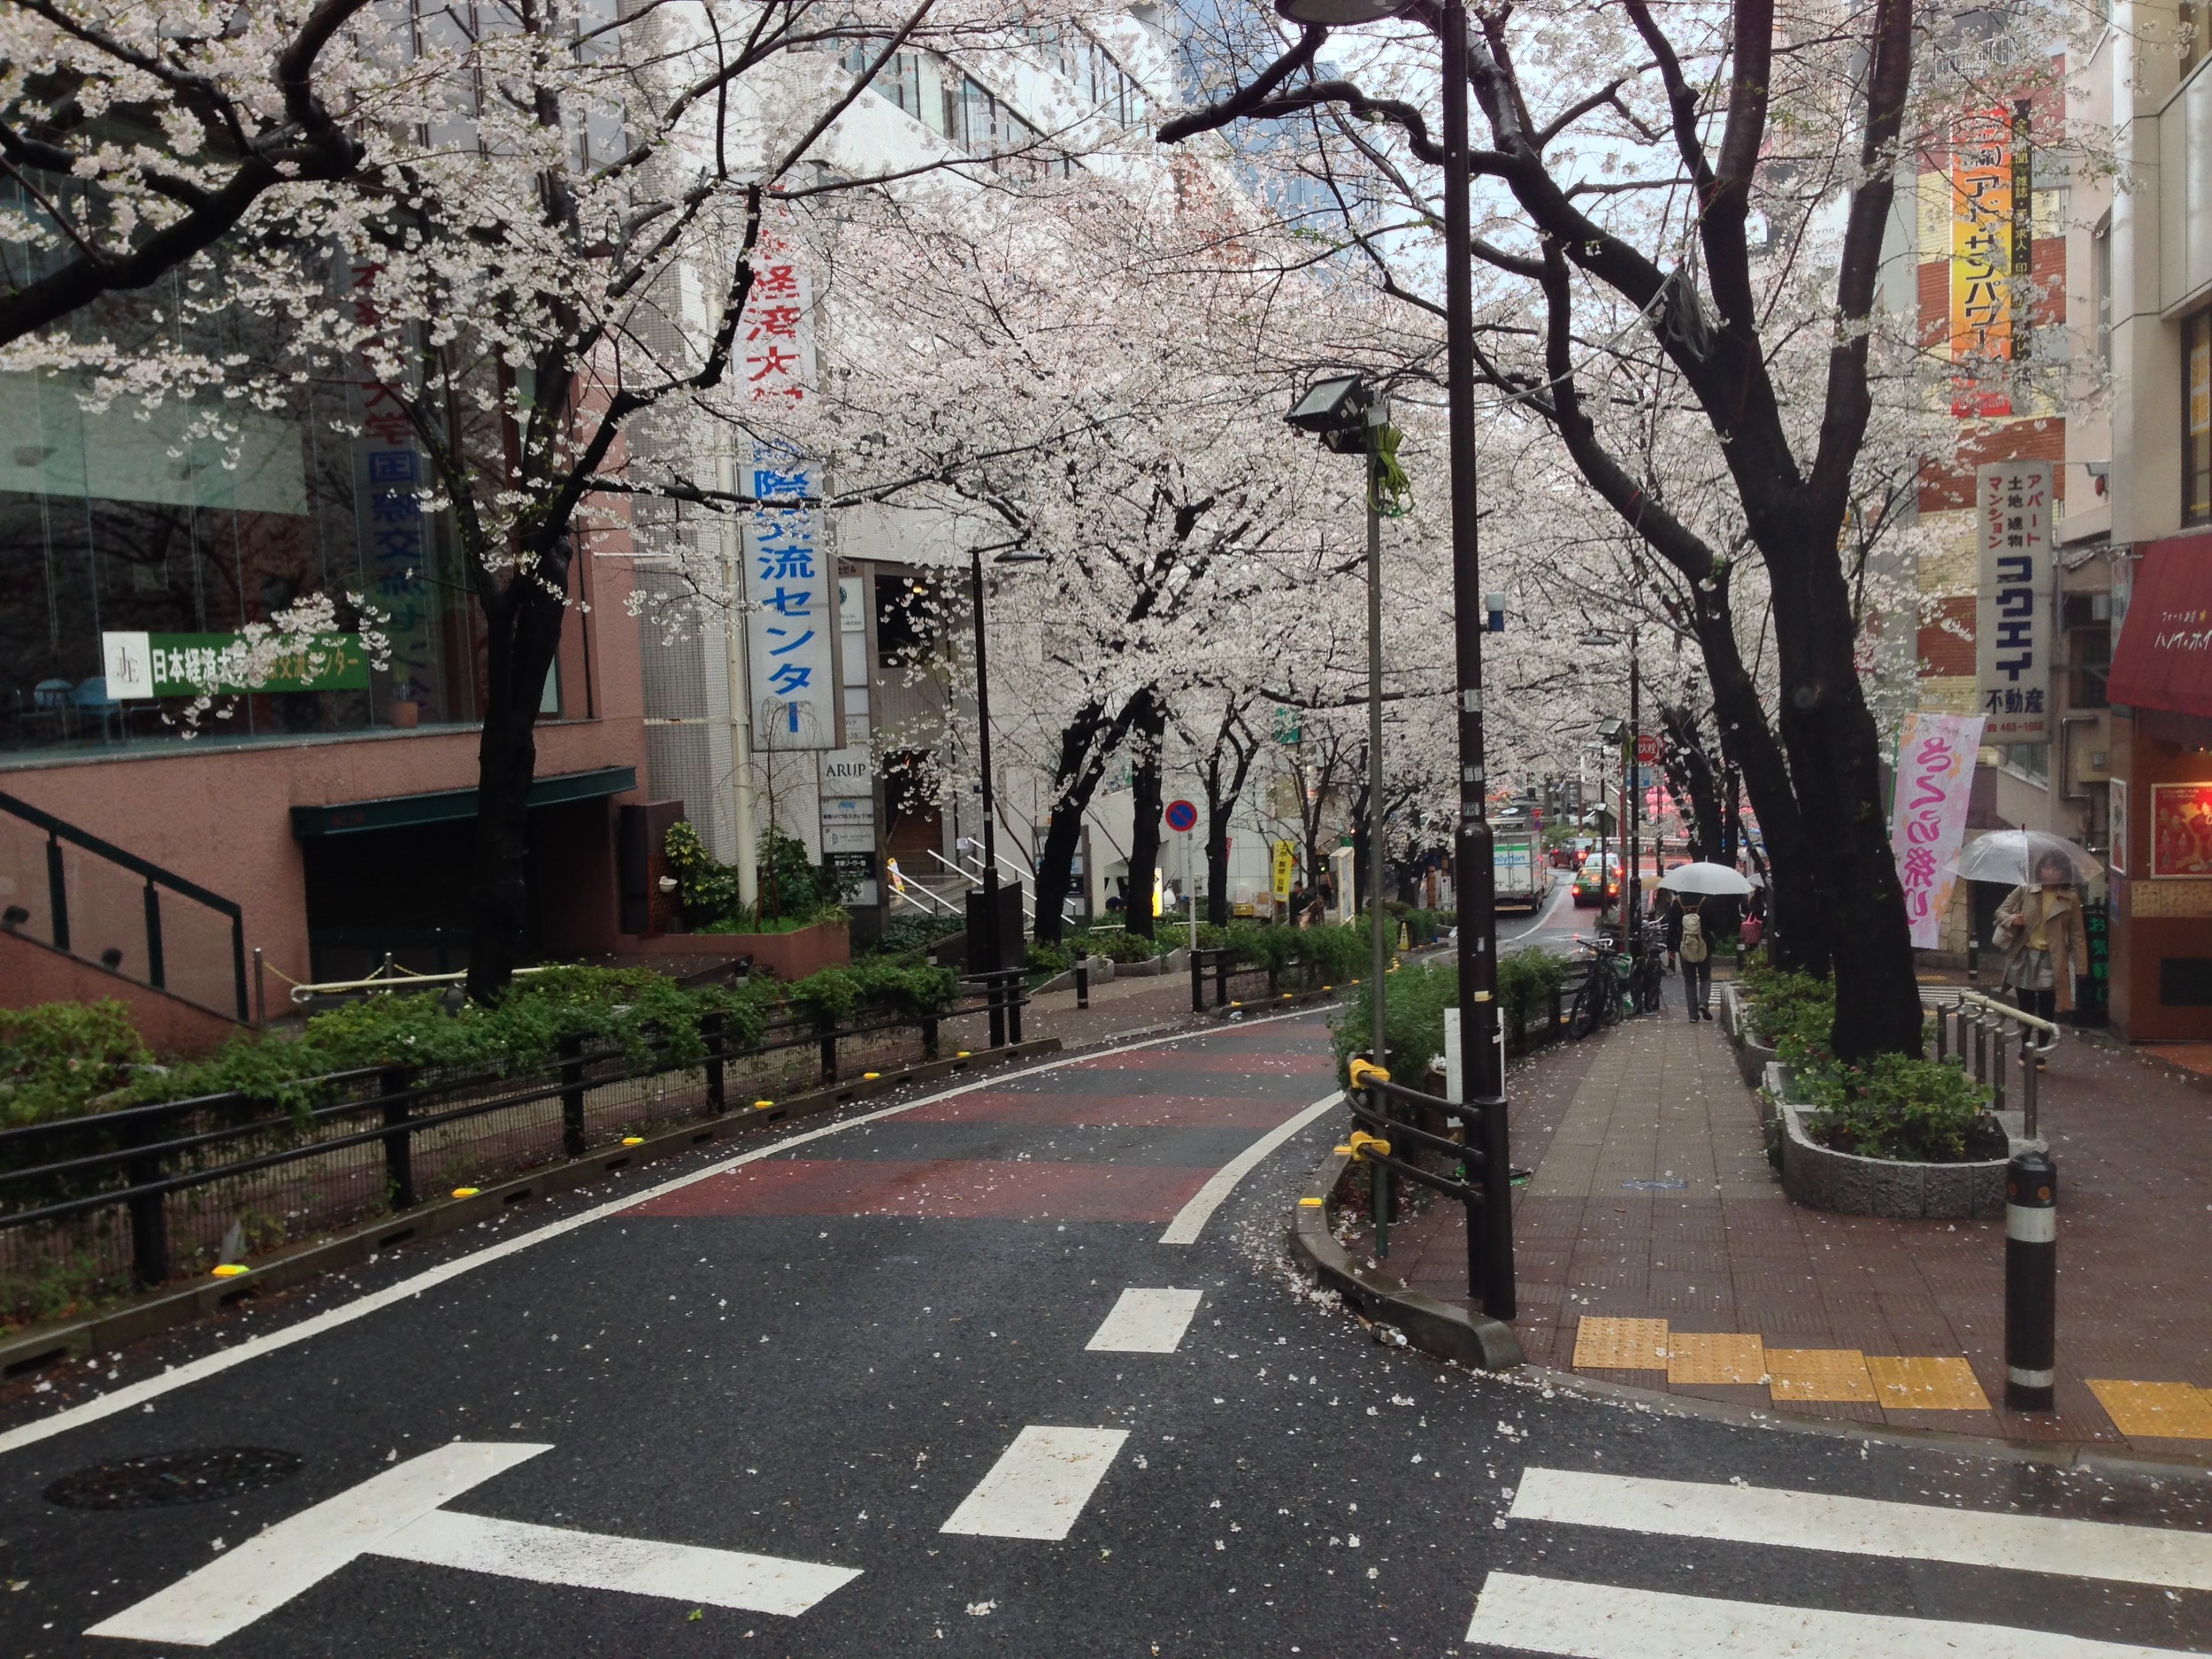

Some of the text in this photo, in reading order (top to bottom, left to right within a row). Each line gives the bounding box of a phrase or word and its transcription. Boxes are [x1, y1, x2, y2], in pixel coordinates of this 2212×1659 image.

[1988, 477, 2003, 549] マンション
[2008, 476, 2024, 508] 土地
[2026, 473, 2044, 547] アパート
[1996, 556, 2033, 681] コクエイ
[1985, 687, 2045, 715] 不動産
[826, 764, 866, 777] ARUP
